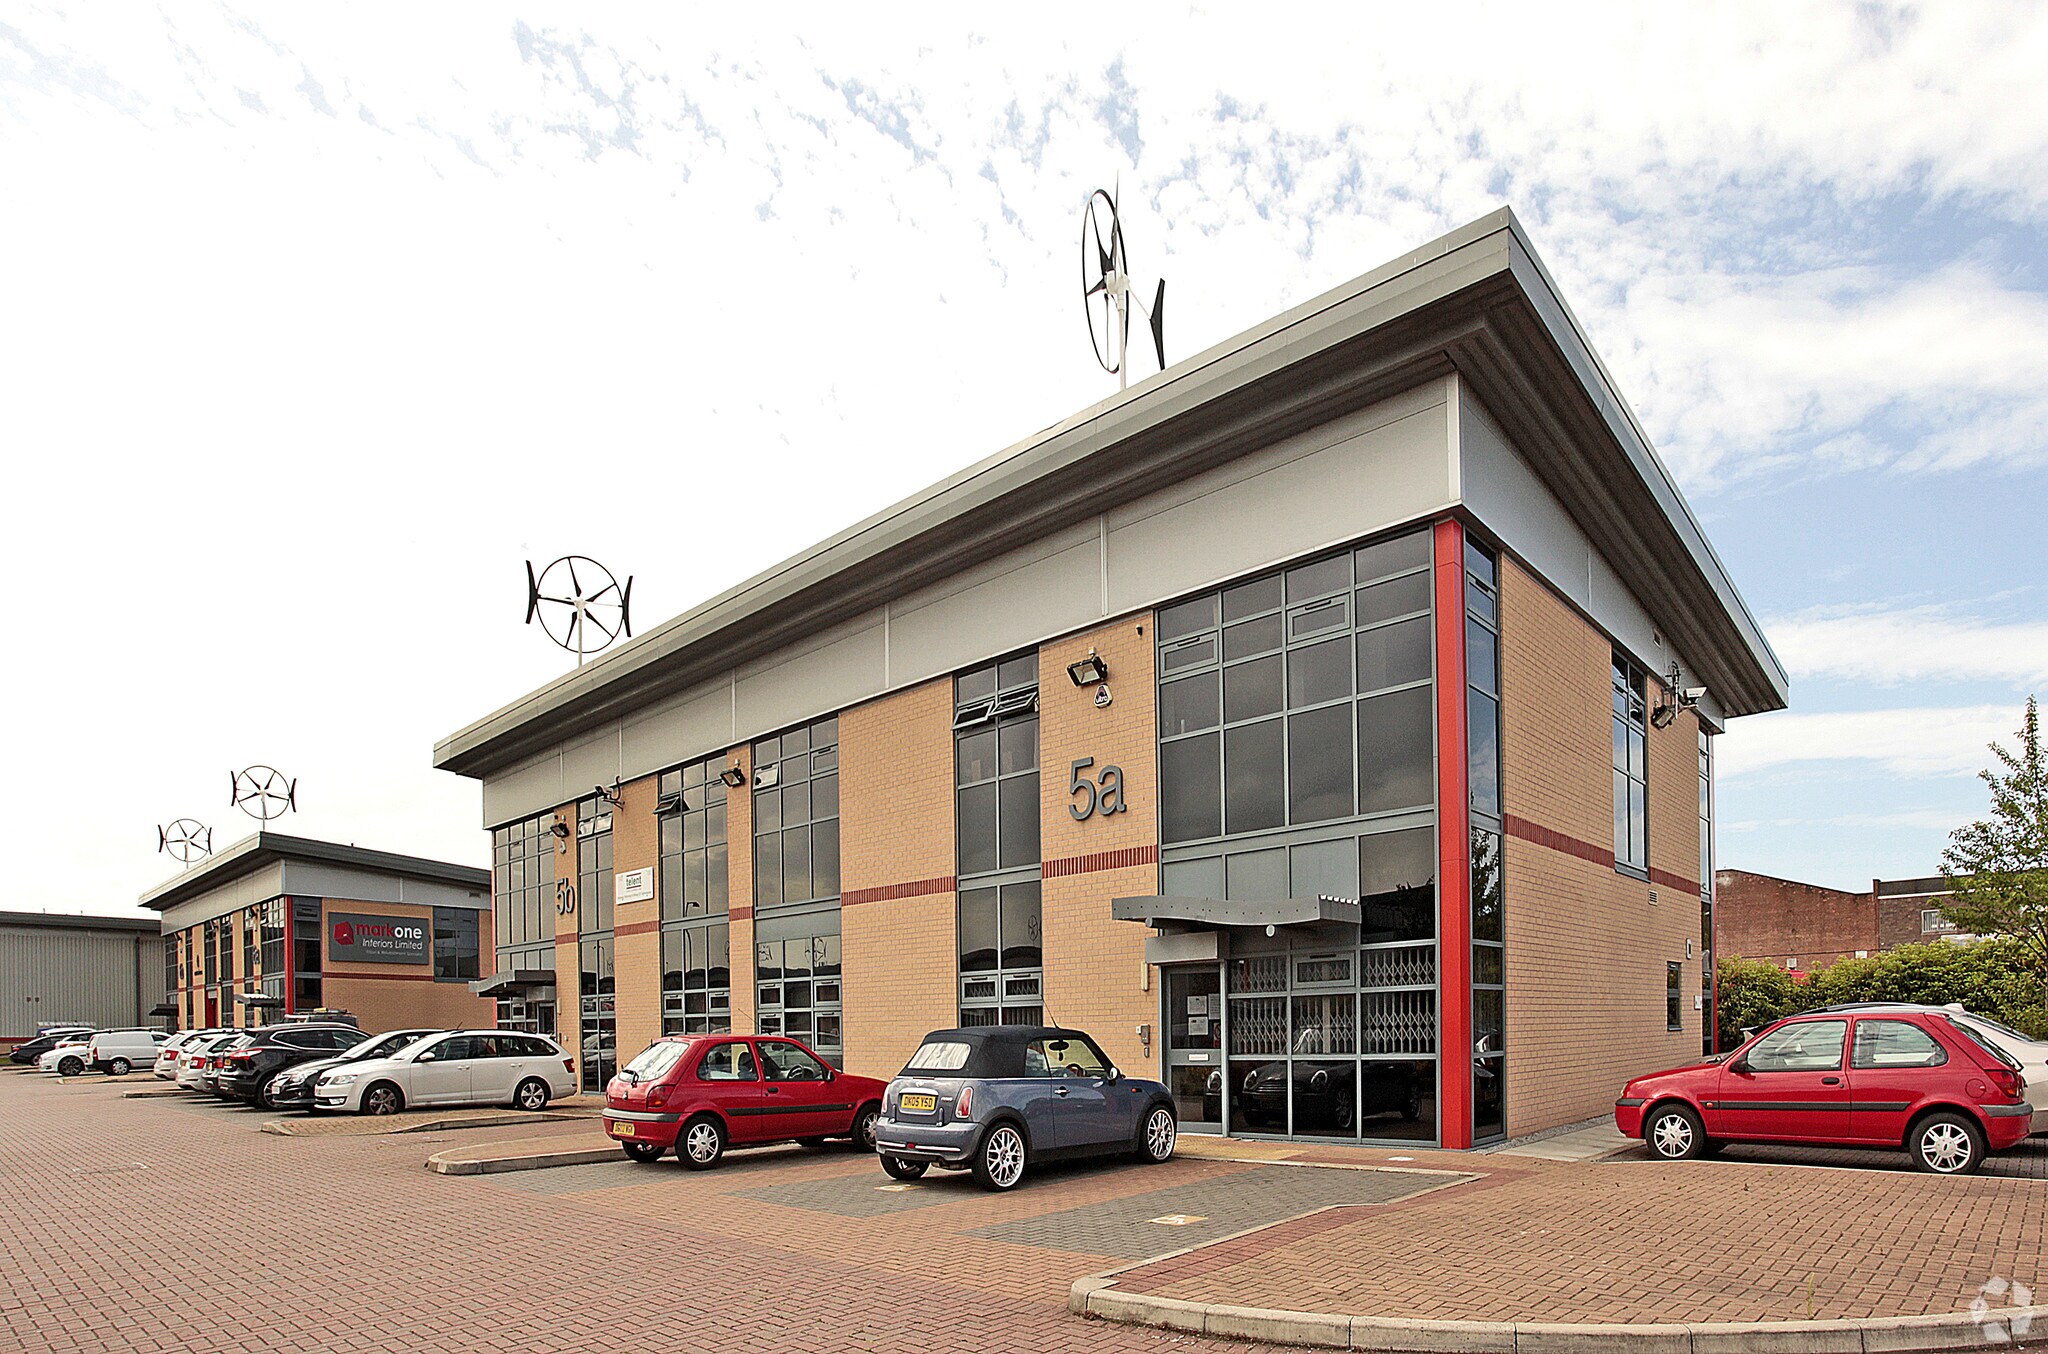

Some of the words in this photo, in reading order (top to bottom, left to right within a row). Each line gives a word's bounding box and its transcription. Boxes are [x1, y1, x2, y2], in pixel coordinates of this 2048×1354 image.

[1069, 756, 1127, 821] 5a
[556, 877, 576, 915] 5b
[362, 938, 393, 949] Interiors
[394, 940, 423, 950] Limited
